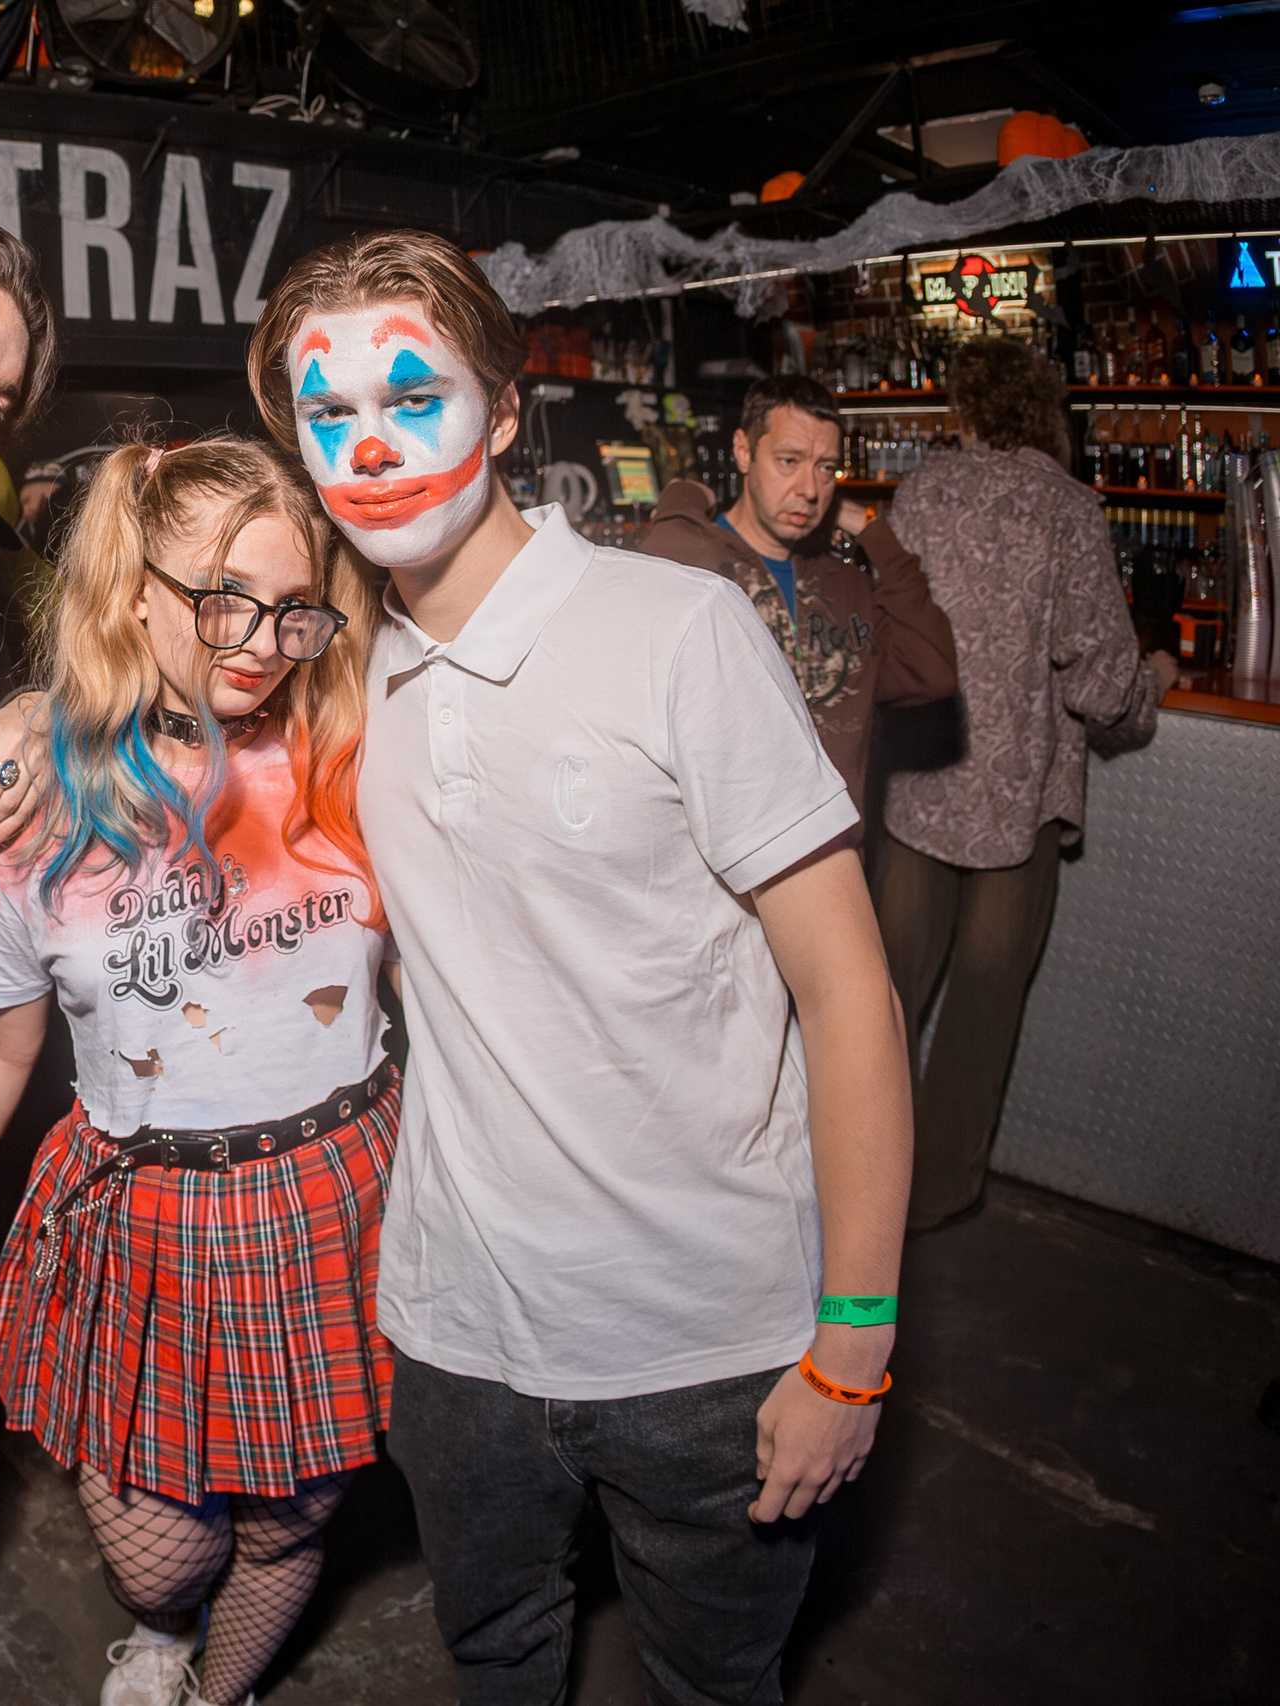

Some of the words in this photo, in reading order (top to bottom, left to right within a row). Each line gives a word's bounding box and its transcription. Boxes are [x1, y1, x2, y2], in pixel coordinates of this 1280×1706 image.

[106, 854, 250, 937] Daddy's
[103, 927, 183, 1011] Lil
[181, 888, 353, 975] Monster
